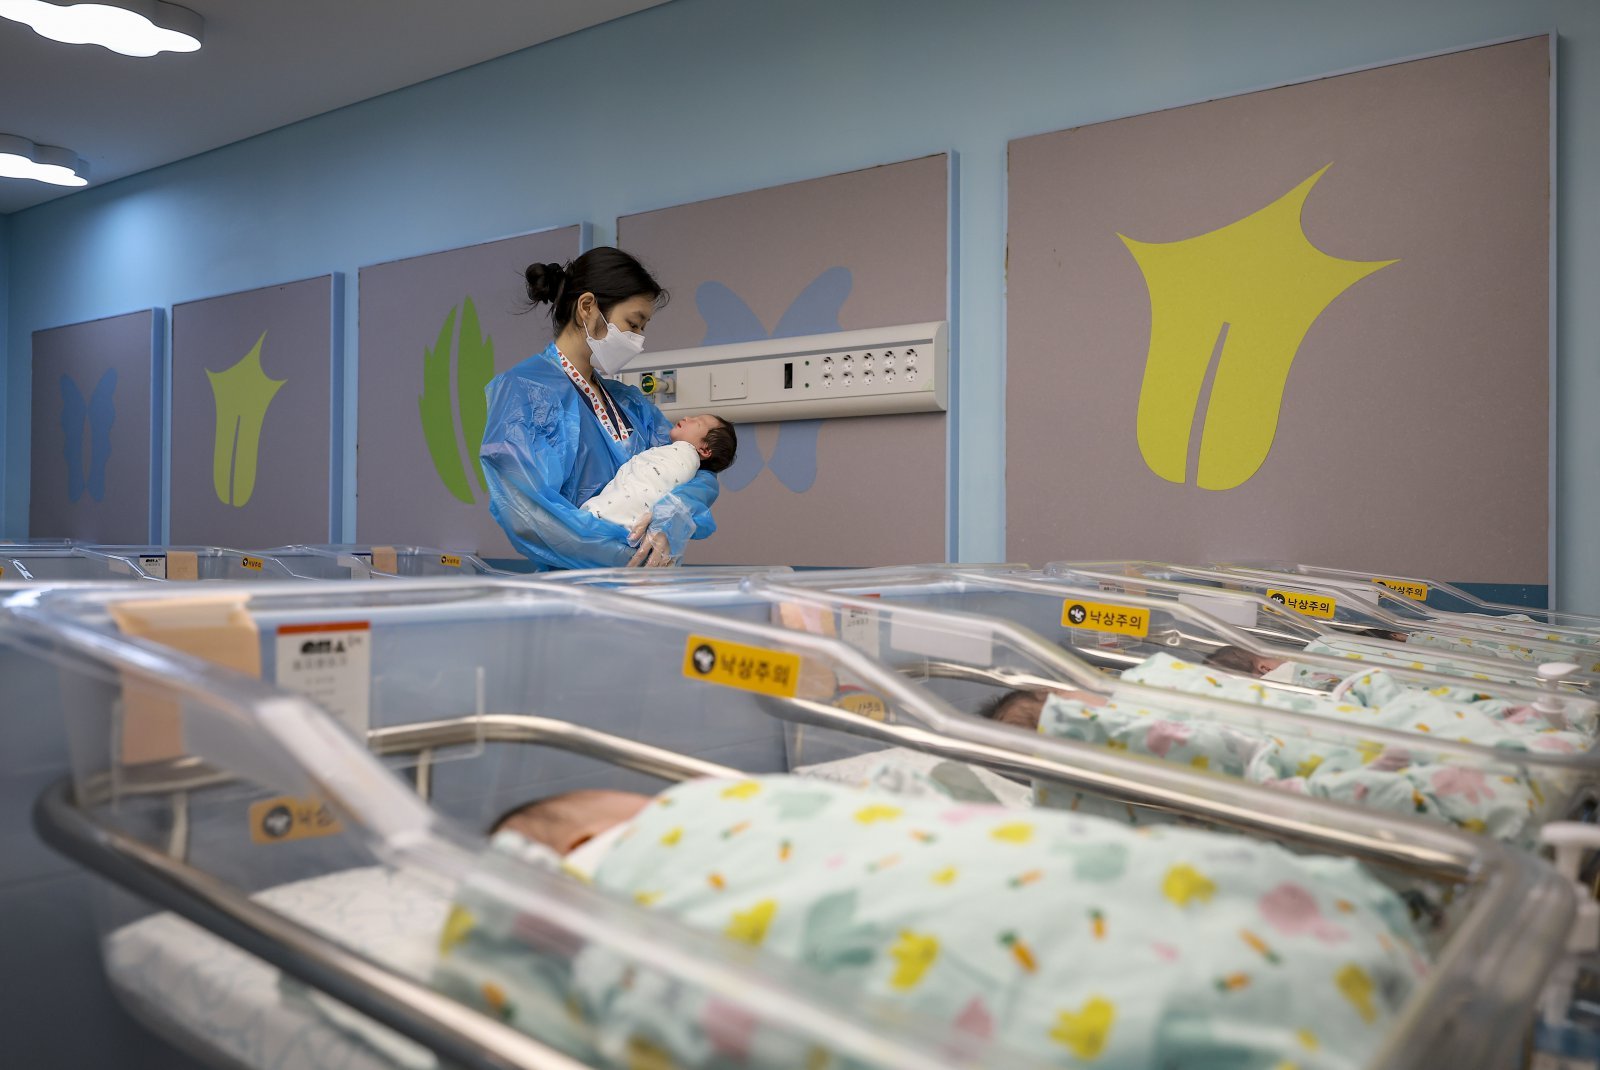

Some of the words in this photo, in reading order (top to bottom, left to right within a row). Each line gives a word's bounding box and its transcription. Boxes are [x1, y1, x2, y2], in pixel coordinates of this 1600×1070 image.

[1389, 585, 1423, 597] 낙상주의
[1288, 598, 1330, 613] 낙상주의
[1090, 611, 1142, 630] 낙상주의
[721, 654, 790, 688] 낙상주의
